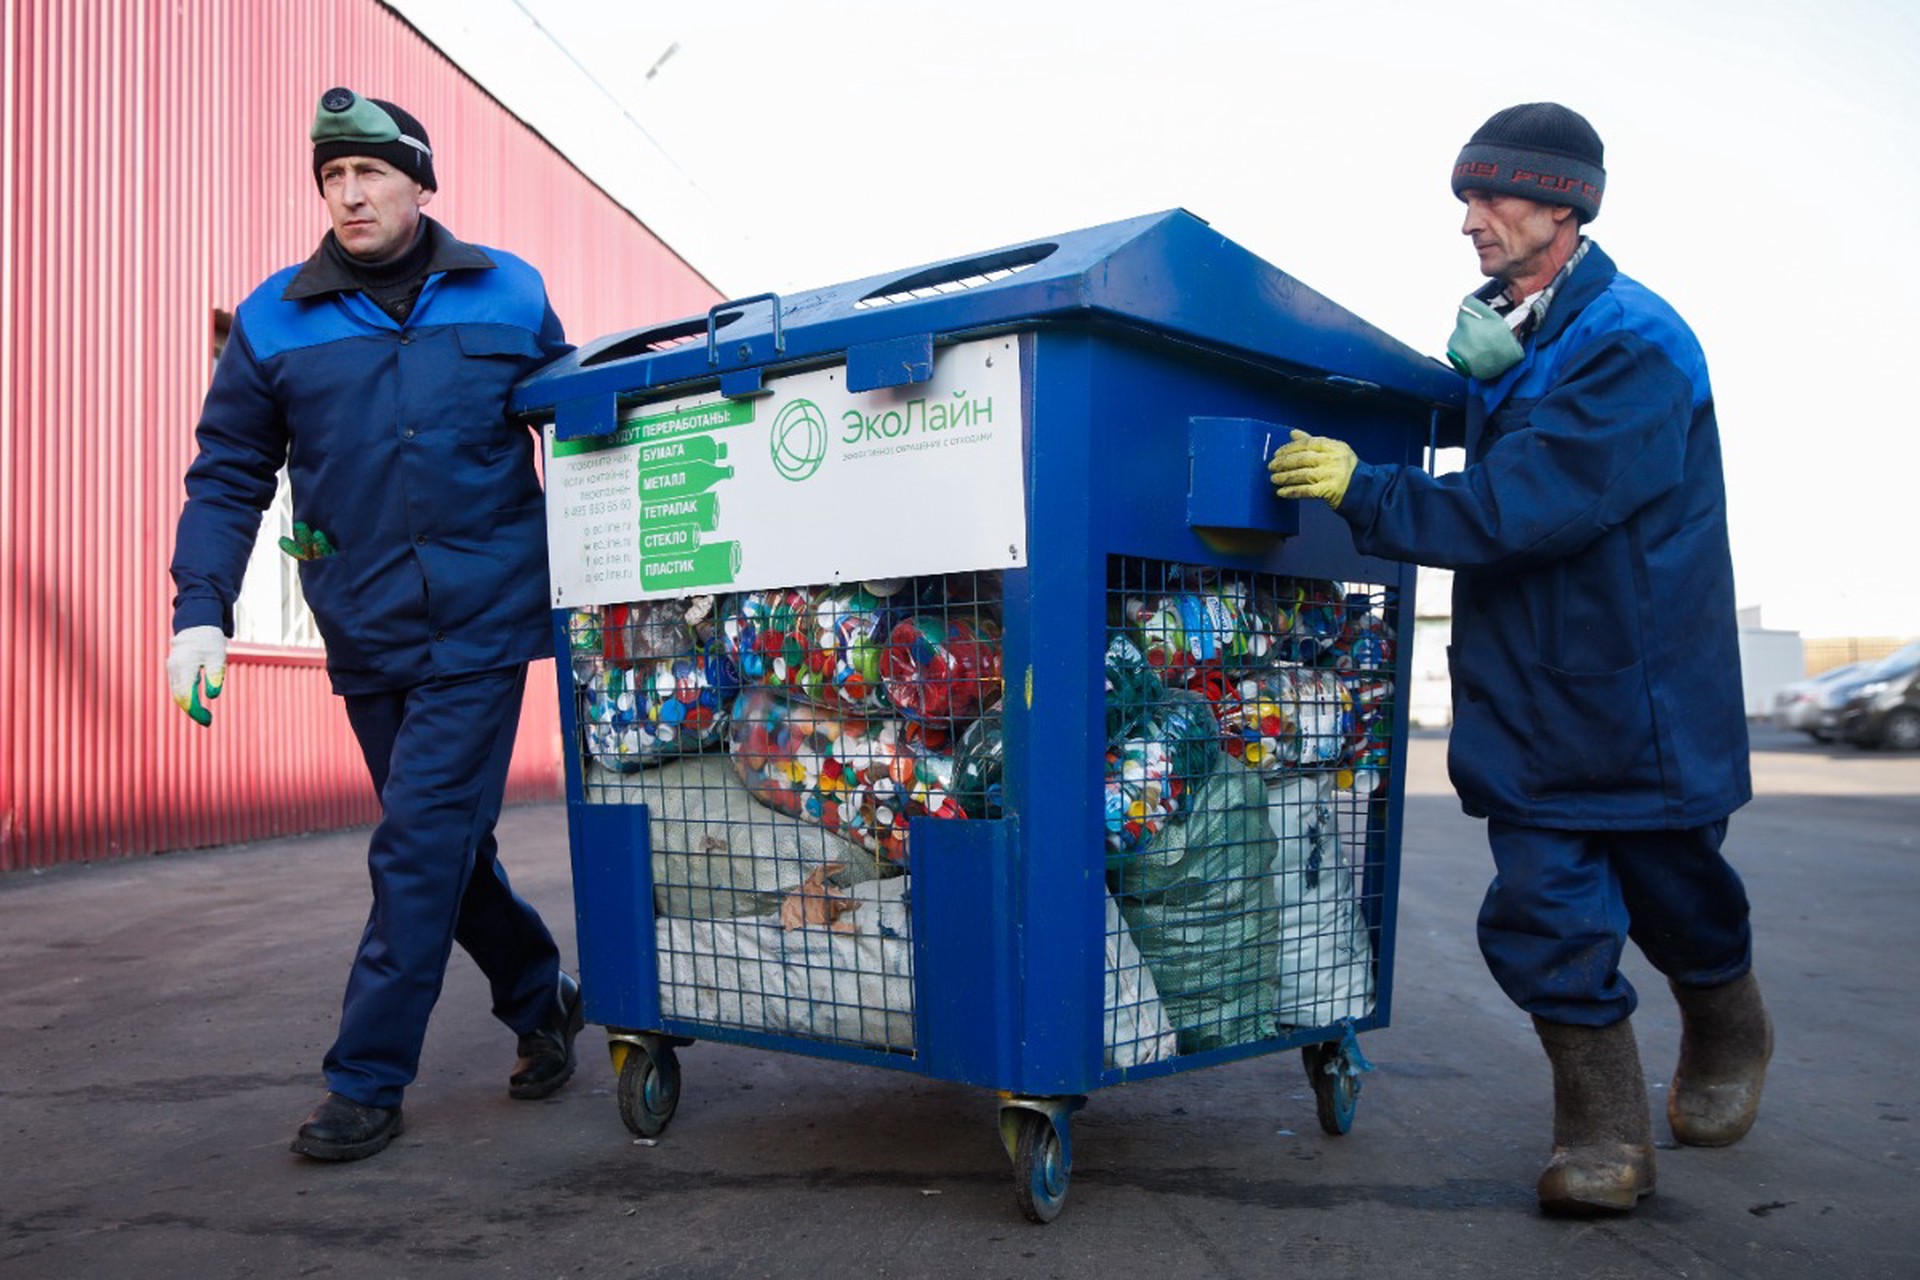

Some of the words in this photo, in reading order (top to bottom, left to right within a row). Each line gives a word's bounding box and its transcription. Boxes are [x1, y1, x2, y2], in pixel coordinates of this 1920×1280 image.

[642, 410, 731, 438] ПЕРЕРАБОТАНЫ:
[841, 389, 993, 445] ЭкоЛайн
[642, 443, 685, 462] БУМАГА
[643, 472, 686, 491] МЕТАЛЛ
[643, 500, 698, 520] ТЕТРАПАК
[644, 532, 687, 549] СТЕКЛО
[644, 559, 695, 577] ПЛАСТИК
